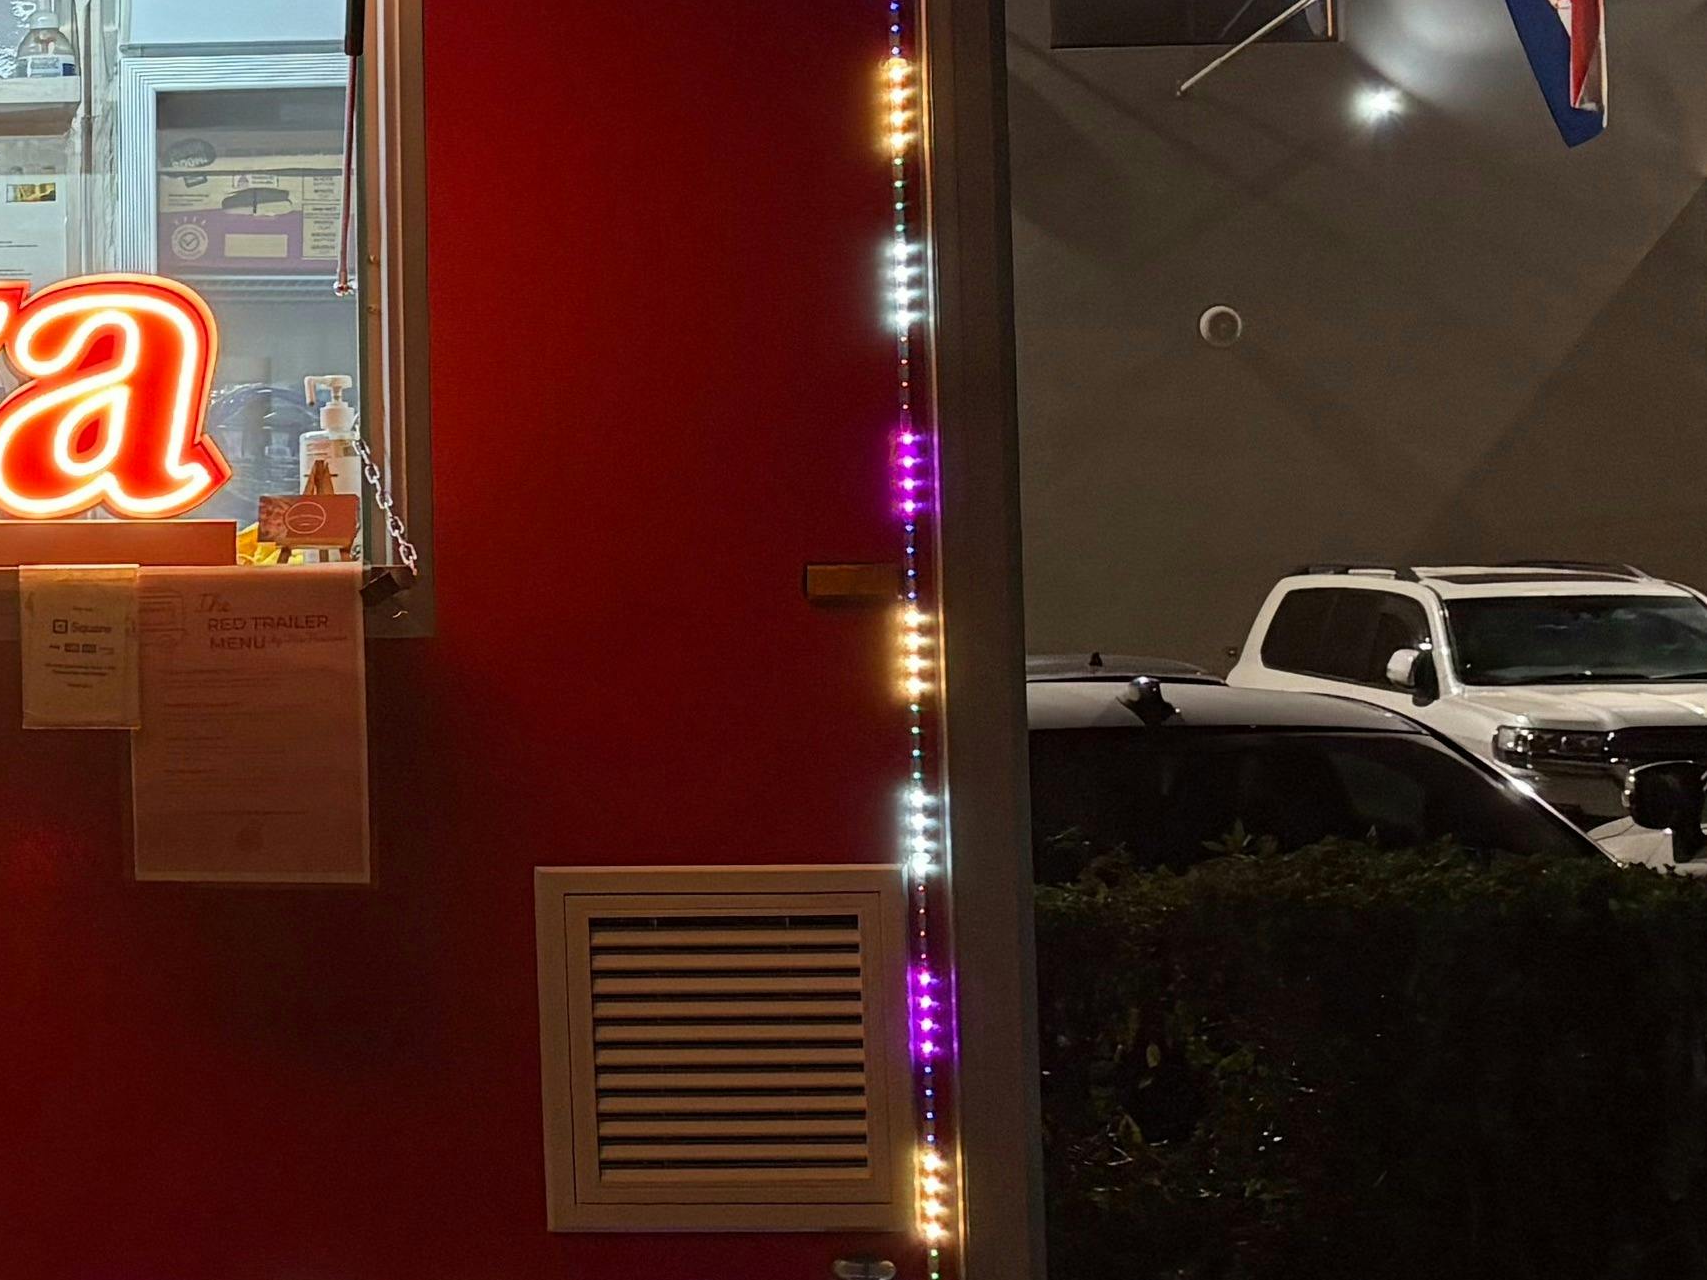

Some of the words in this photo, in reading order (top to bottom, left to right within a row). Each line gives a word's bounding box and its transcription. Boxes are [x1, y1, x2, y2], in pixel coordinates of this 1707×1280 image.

[208, 617, 247, 631] RED
[251, 614, 328, 630] TRAILER
[209, 636, 266, 650] MENU
